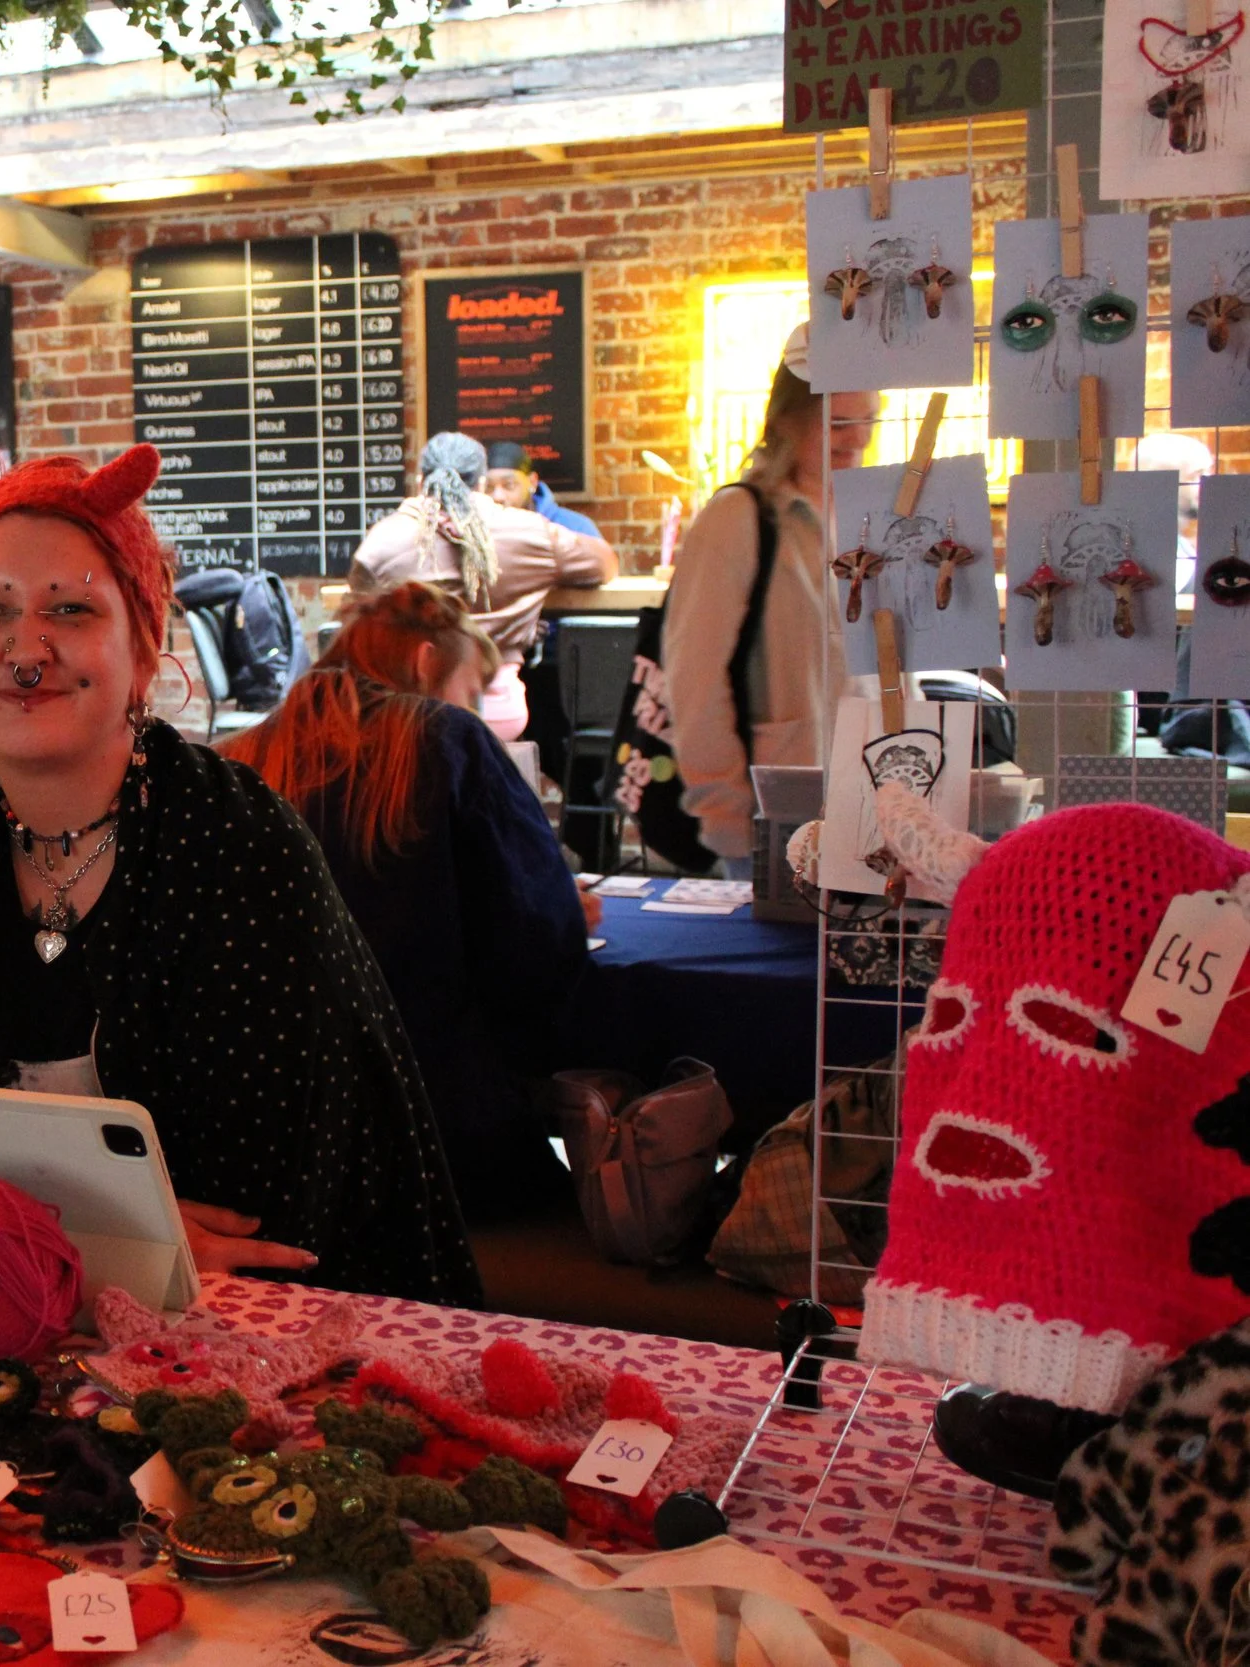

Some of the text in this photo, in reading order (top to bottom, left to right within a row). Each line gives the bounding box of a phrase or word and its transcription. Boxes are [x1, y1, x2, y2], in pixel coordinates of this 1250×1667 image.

[899, 56, 1000, 116] £20
[141, 300, 181, 316] Amstel
[252, 297, 282, 312] lager
[447, 289, 565, 320] loaded.
[168, 330, 209, 346] Moretti
[253, 326, 283, 342] lager
[143, 363, 172, 377] Neck
[254, 357, 297, 371] session
[144, 393, 190, 408] Virtuous
[255, 387, 275, 402] IPA
[144, 424, 196, 440] Guinness
[256, 418, 286, 433] stout
[257, 449, 287, 463] stout
[257, 479, 318, 494] apple cider
[196, 510, 229, 524] Monk
[1153, 933, 1221, 995] £45
[595, 1436, 645, 1463] £30
[65, 1592, 116, 1617] £25
